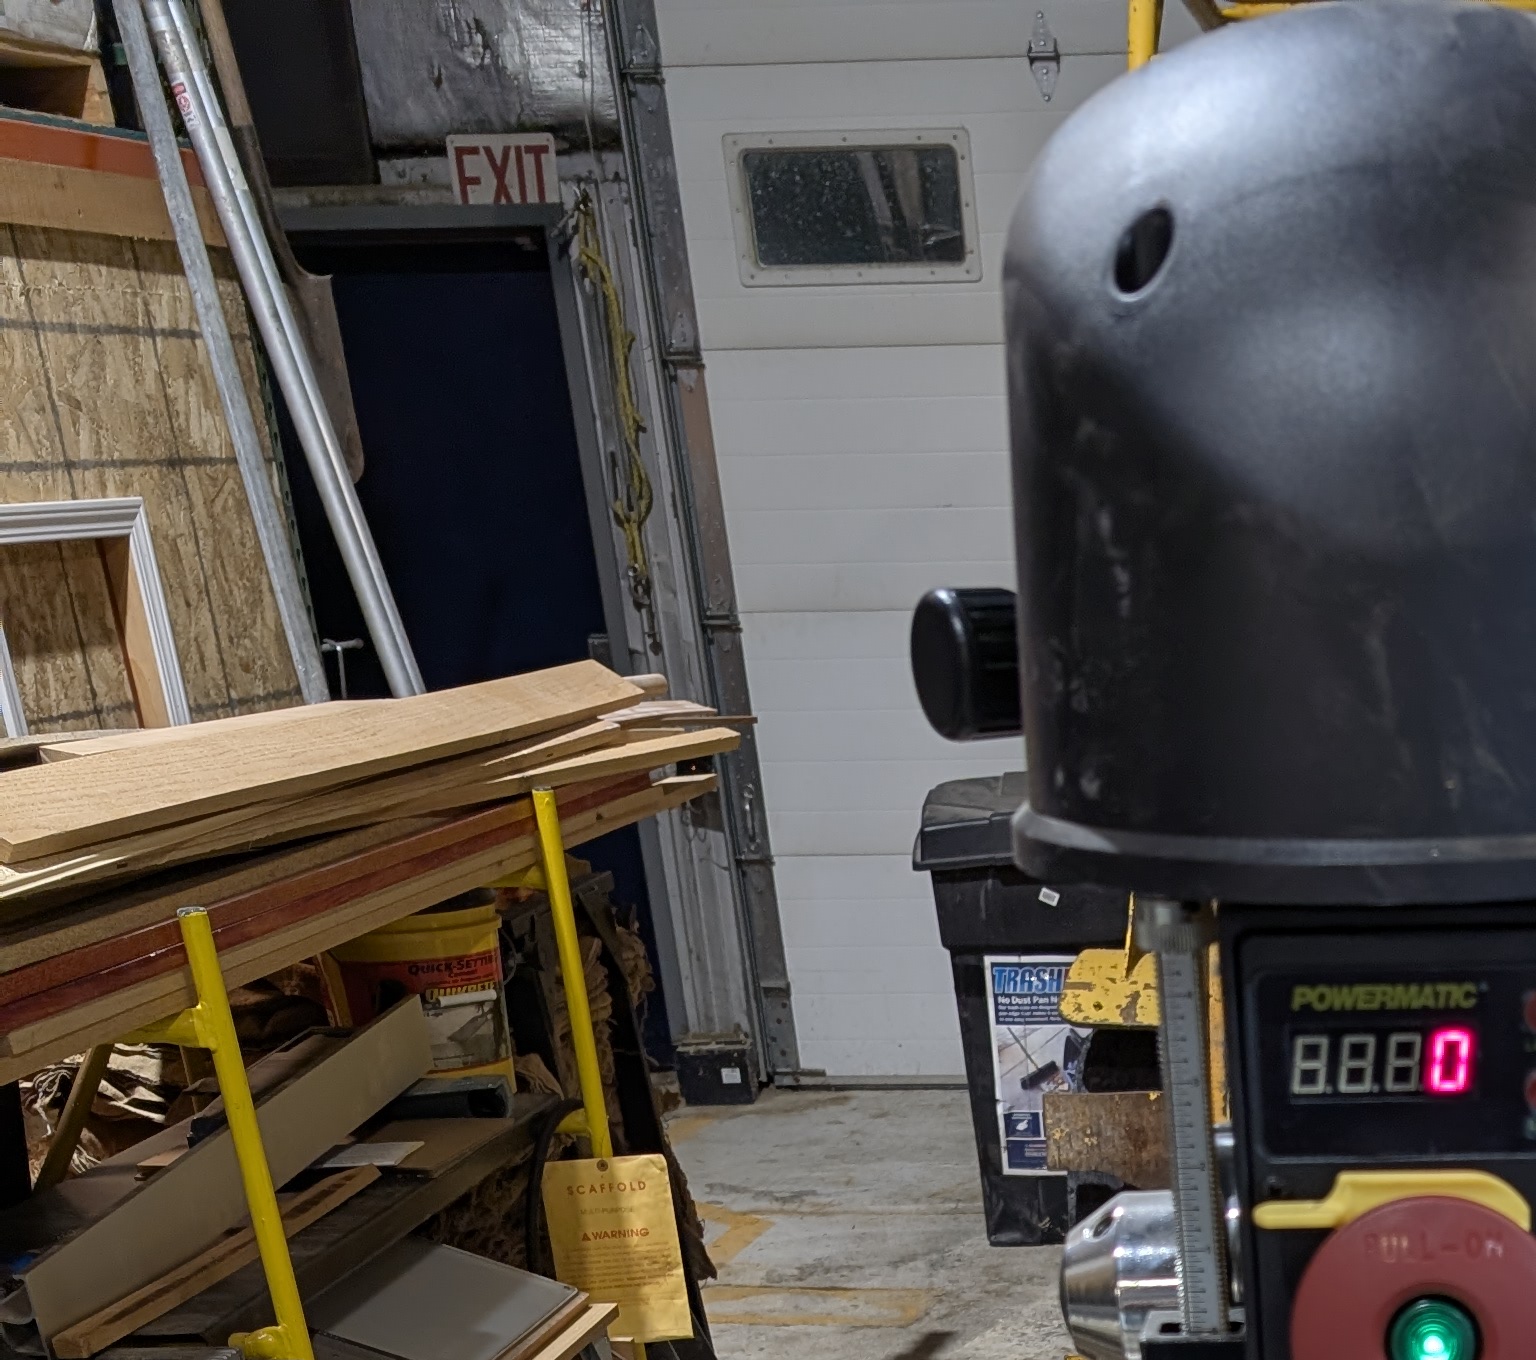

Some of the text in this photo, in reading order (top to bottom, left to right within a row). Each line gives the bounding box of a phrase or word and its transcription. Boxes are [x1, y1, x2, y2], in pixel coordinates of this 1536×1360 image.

[454, 145, 549, 204] EXIT
[993, 966, 1068, 994] TRASH
[1292, 983, 1477, 1012] POWERMATIC
[566, 1180, 647, 1196] SCAFFOLD
[592, 1228, 650, 1240] WARNING
